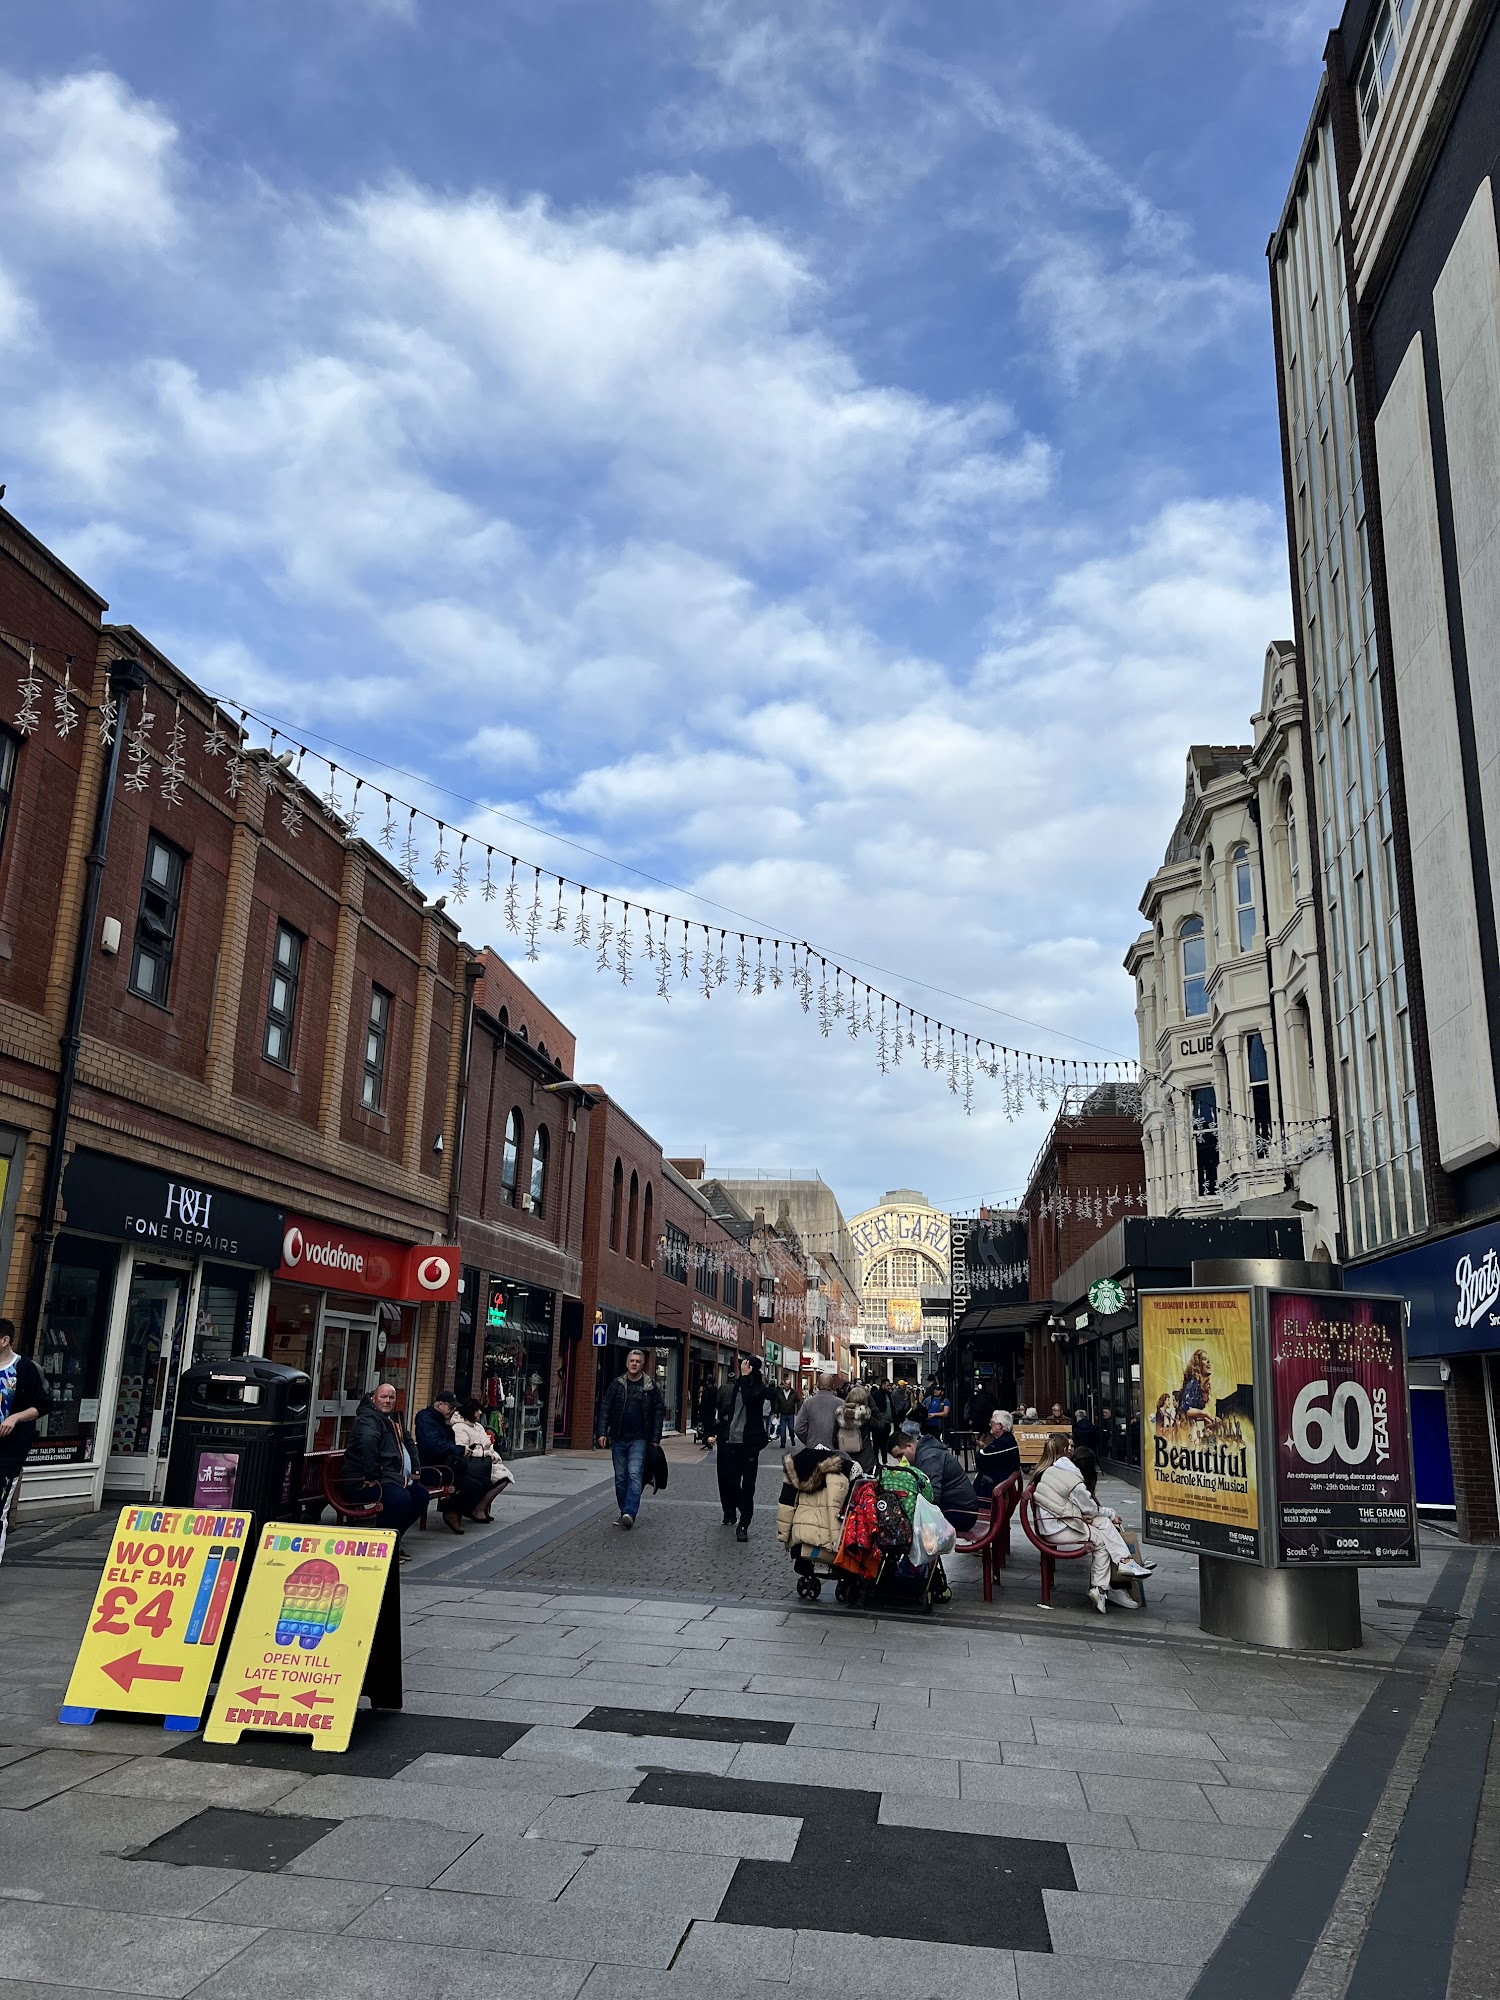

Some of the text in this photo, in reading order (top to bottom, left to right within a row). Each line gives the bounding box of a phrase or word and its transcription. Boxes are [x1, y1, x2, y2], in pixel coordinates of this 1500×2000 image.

[1181, 1036, 1213, 1056] CLUB
[164, 1182, 213, 1229] H&H
[125, 1215, 238, 1254] FONE REPAIRS
[851, 1215, 950, 1256] TER GARD
[305, 1241, 364, 1274] vodafone
[1455, 1248, 1500, 1328] Boots
[1283, 1319, 1392, 1343] BLACKPOOL
[1281, 1341, 1393, 1363] GANG SHOW
[201, 1426, 246, 1436] LITTER
[1292, 1380, 1374, 1465] 60
[1373, 1388, 1390, 1465] YEARS
[1154, 1435, 1247, 1478] Beautiful
[1154, 1469, 1248, 1494] The Carole King Musical
[1295, 1472, 1328, 1480] extravaganza
[1335, 1473, 1349, 1481] song,
[1377, 1474, 1399, 1482] comedy!
[1283, 1507, 1332, 1515] blackpoolgrand.co.uk
[1359, 1508, 1406, 1518] THE GRAND
[125, 1510, 246, 1539] FIDGET CORNER
[1165, 1520, 1174, 1528] SAT
[1180, 1523, 1191, 1531] OCT
[1229, 1531, 1255, 1542] THE GRAND
[116, 1541, 195, 1569] WOW
[263, 1534, 389, 1559] FIDGET CORNER
[1286, 1548, 1308, 1556] Scouts
[107, 1568, 187, 1587] ELF BAR
[92, 1586, 174, 1638] £4
[263, 1652, 330, 1668] OPEN TILL
[244, 1668, 342, 1685] LATE TONIGHT
[225, 1707, 335, 1730] ENTRANCE
